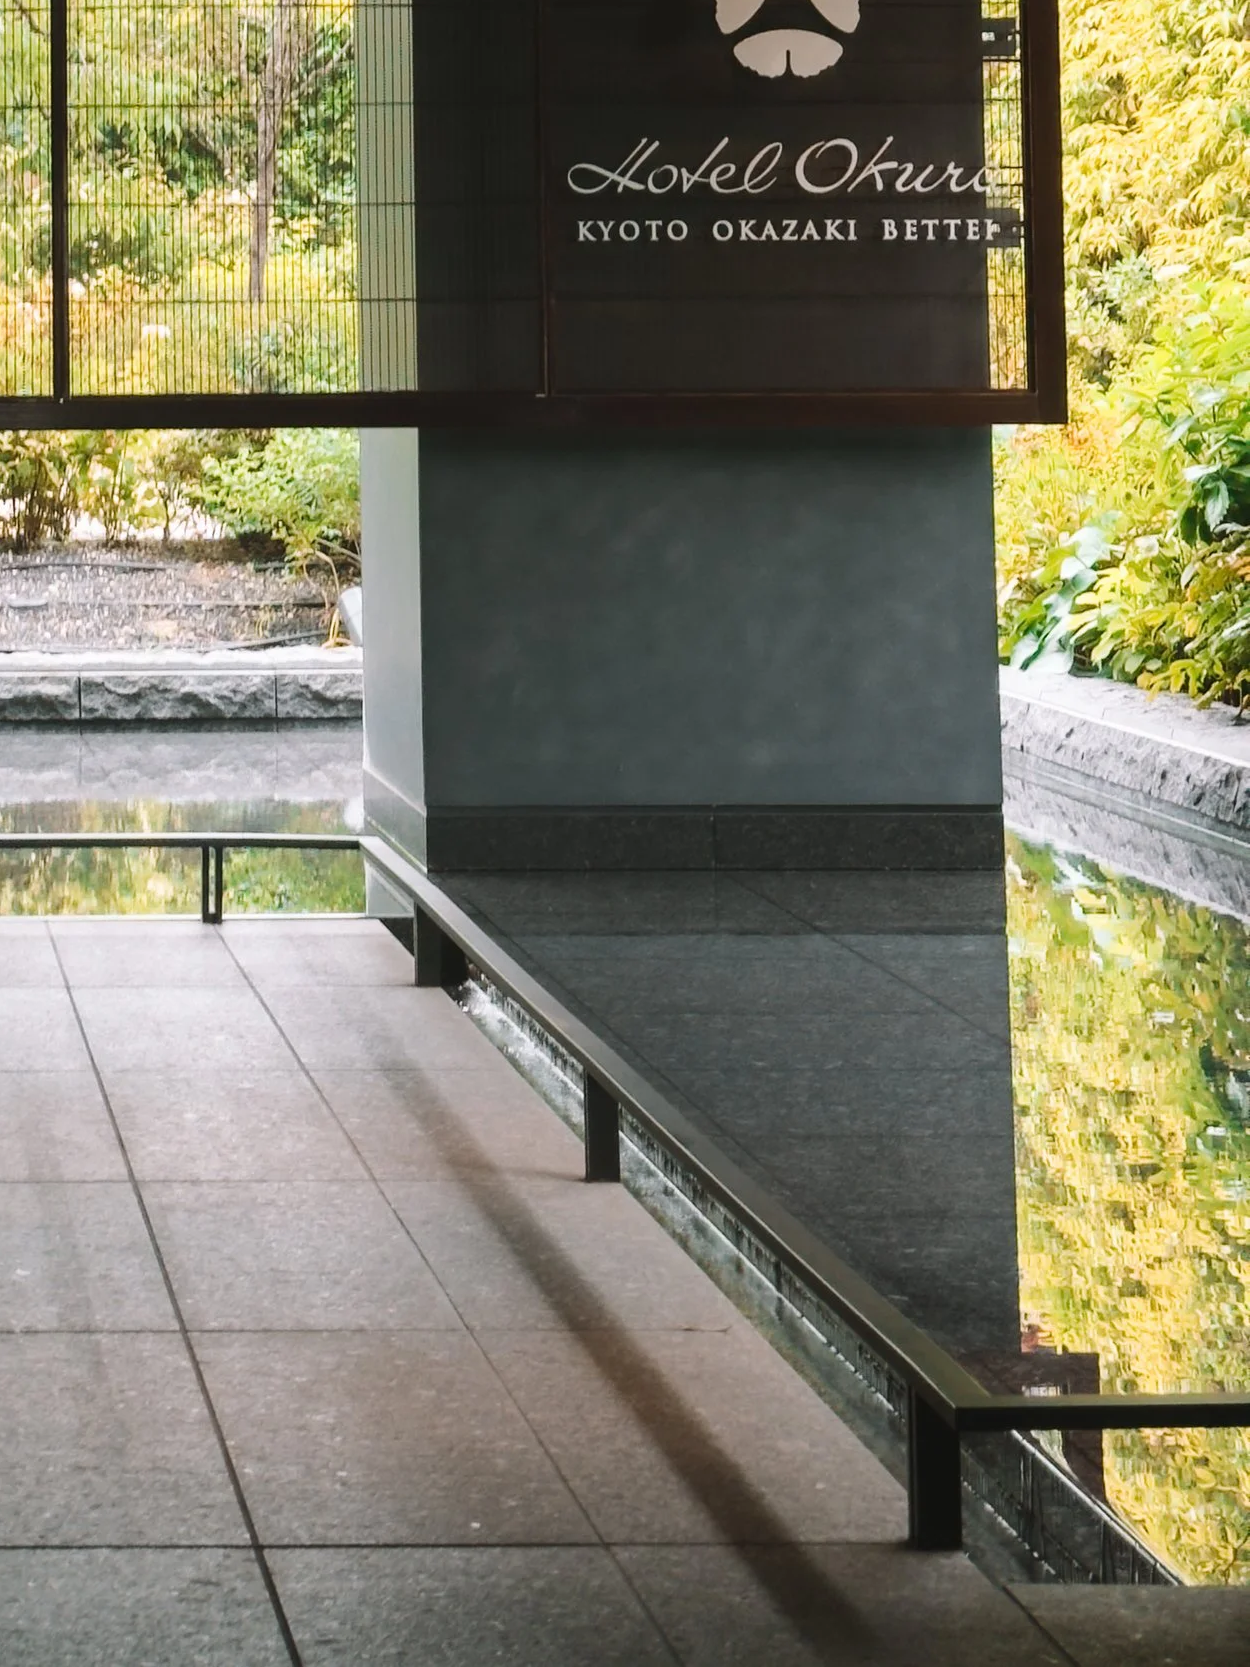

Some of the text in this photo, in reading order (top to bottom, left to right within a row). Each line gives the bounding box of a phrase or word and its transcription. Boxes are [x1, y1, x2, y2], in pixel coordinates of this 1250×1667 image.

[567, 137, 783, 195] Hotel
[577, 220, 689, 243] KYOTO
[712, 219, 858, 242] OKAZAKI
